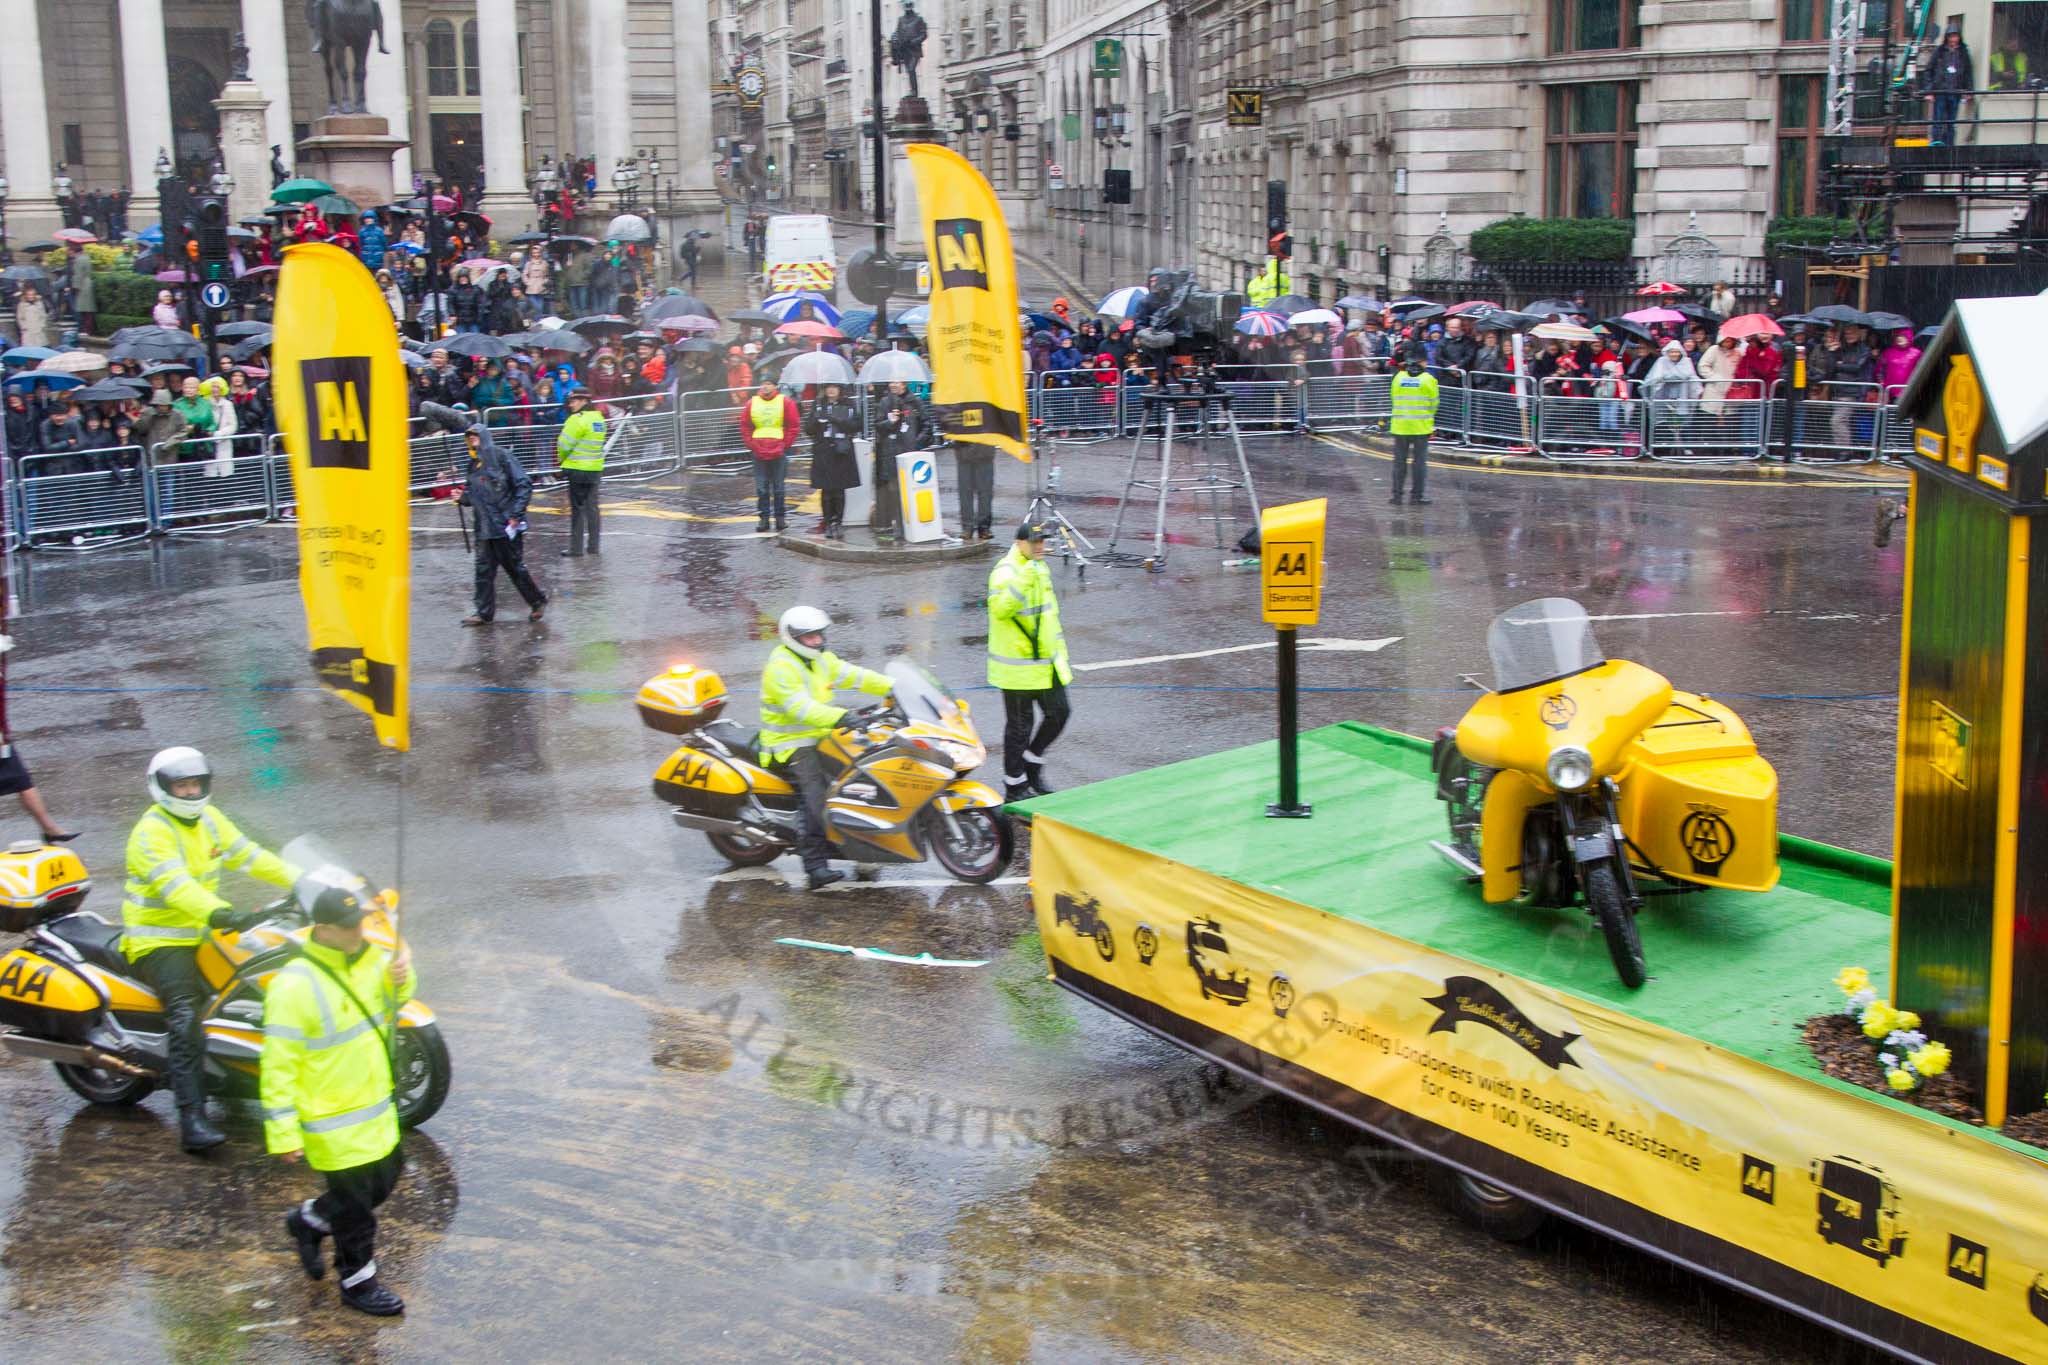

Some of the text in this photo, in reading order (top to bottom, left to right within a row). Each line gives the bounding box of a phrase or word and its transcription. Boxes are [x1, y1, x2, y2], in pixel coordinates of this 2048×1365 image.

[1273, 552, 1306, 576] AA
[670, 754, 713, 788] AA
[0, 956, 53, 1002] AA
[1321, 1009, 1702, 1172] Providing Londoners with Roadside Assistance
[1421, 1073, 1570, 1148] for over 100 Years
[1743, 1164, 1771, 1195] AA
[1949, 1246, 1986, 1279] AA
